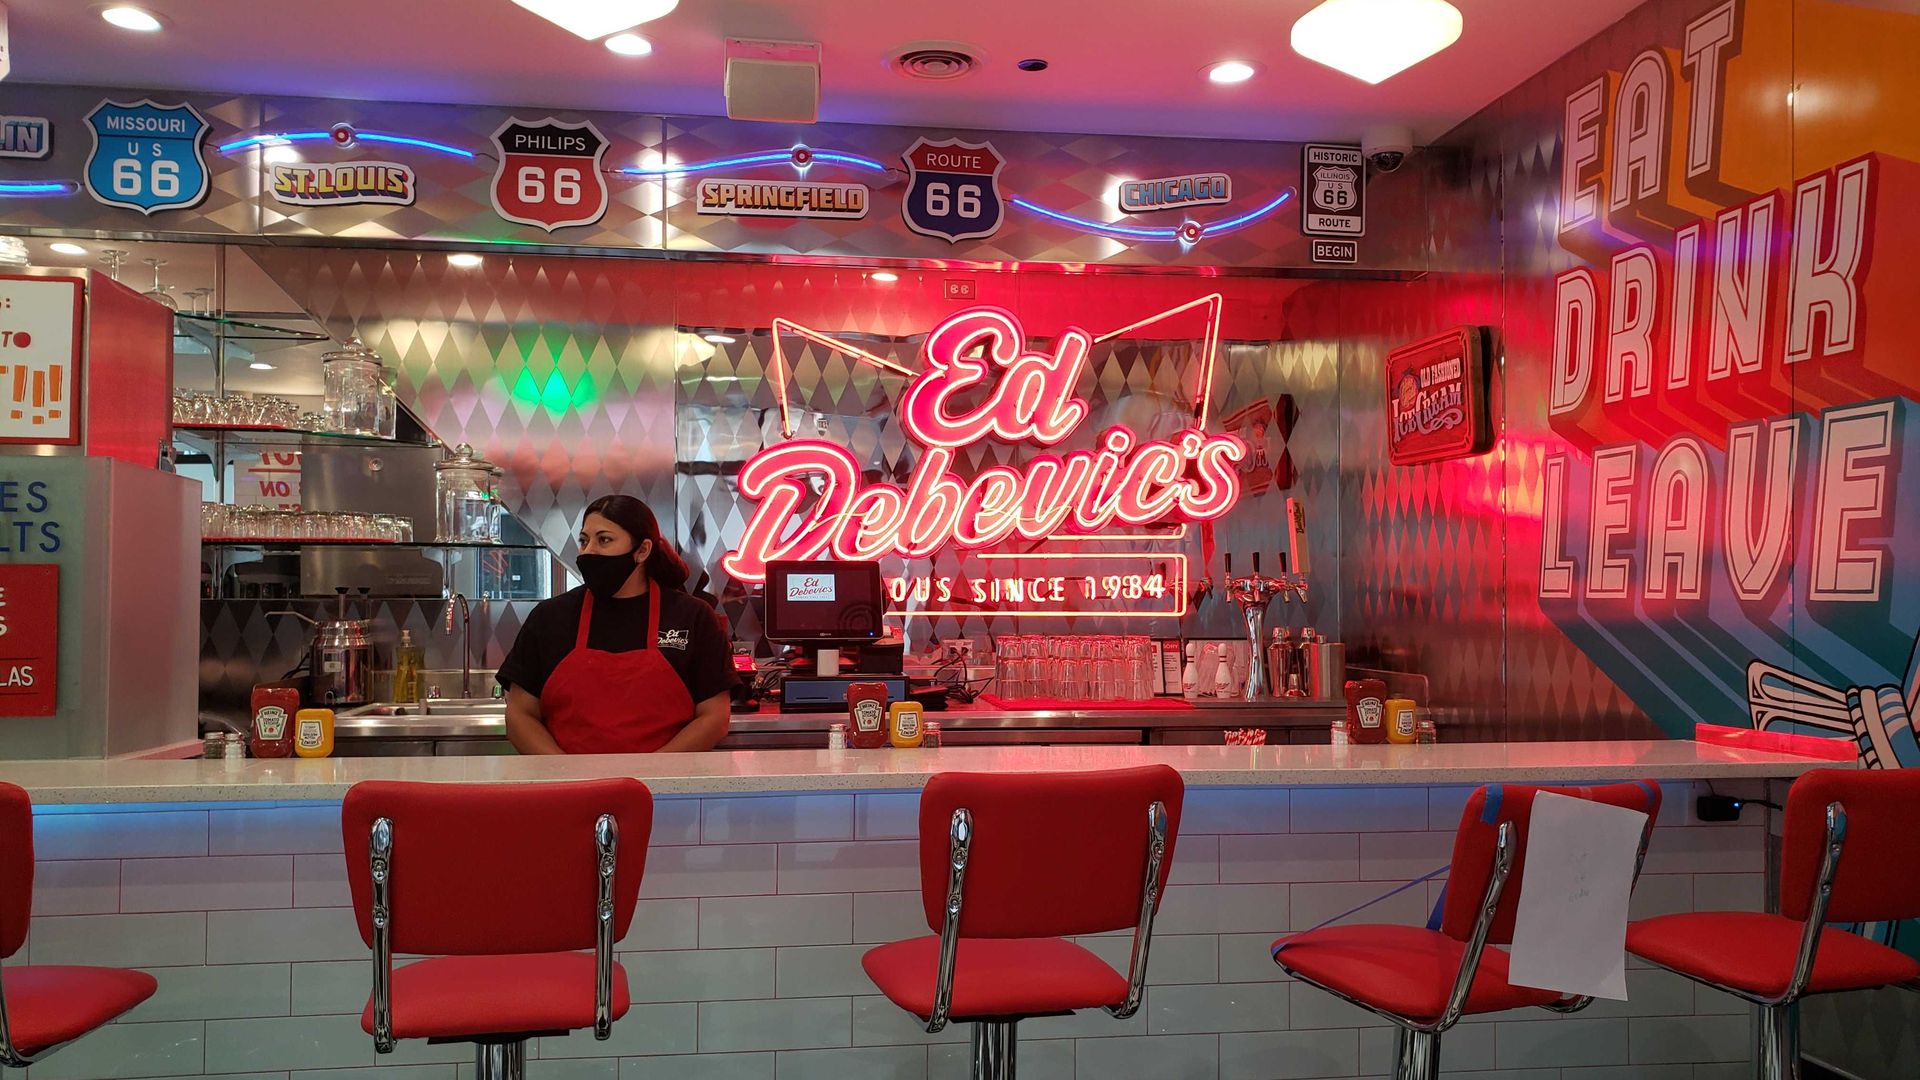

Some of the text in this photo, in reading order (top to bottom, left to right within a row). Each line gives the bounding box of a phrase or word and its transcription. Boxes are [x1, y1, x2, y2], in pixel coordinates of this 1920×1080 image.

[106, 115, 186, 133] MISSOURI
[1560, 0, 1735, 233] EAT
[0, 122, 43, 153] IN
[127, 142, 162, 157] U S
[515, 134, 586, 151] PHILIPS
[926, 153, 981, 169] ROUTE
[1313, 151, 1358, 162] HISTORIC
[113, 158, 180, 197] 66
[518, 166, 581, 205] 66
[1320, 172, 1351, 180] ILLINOIS
[702, 183, 864, 212] SPRINGFIELD
[926, 182, 981, 219] 66
[1124, 176, 1228, 206] CHICAGO
[1323, 190, 1348, 205] 66
[1318, 217, 1351, 228] ROUTE
[1317, 245, 1353, 258] BEGIN
[1549, 160, 1872, 416] DRINK
[902, 305, 1093, 448] Ed
[1420, 367, 1431, 388] OLD
[1392, 383, 1462, 443] ICE CREAM
[0, 481, 48, 513] ES
[722, 424, 1247, 583] Debevic's
[1540, 401, 1897, 602] LEAVE
[804, 577, 819, 587] Ed
[972, 577, 1065, 602] SINCE
[1084, 574, 1165, 600] 1984
